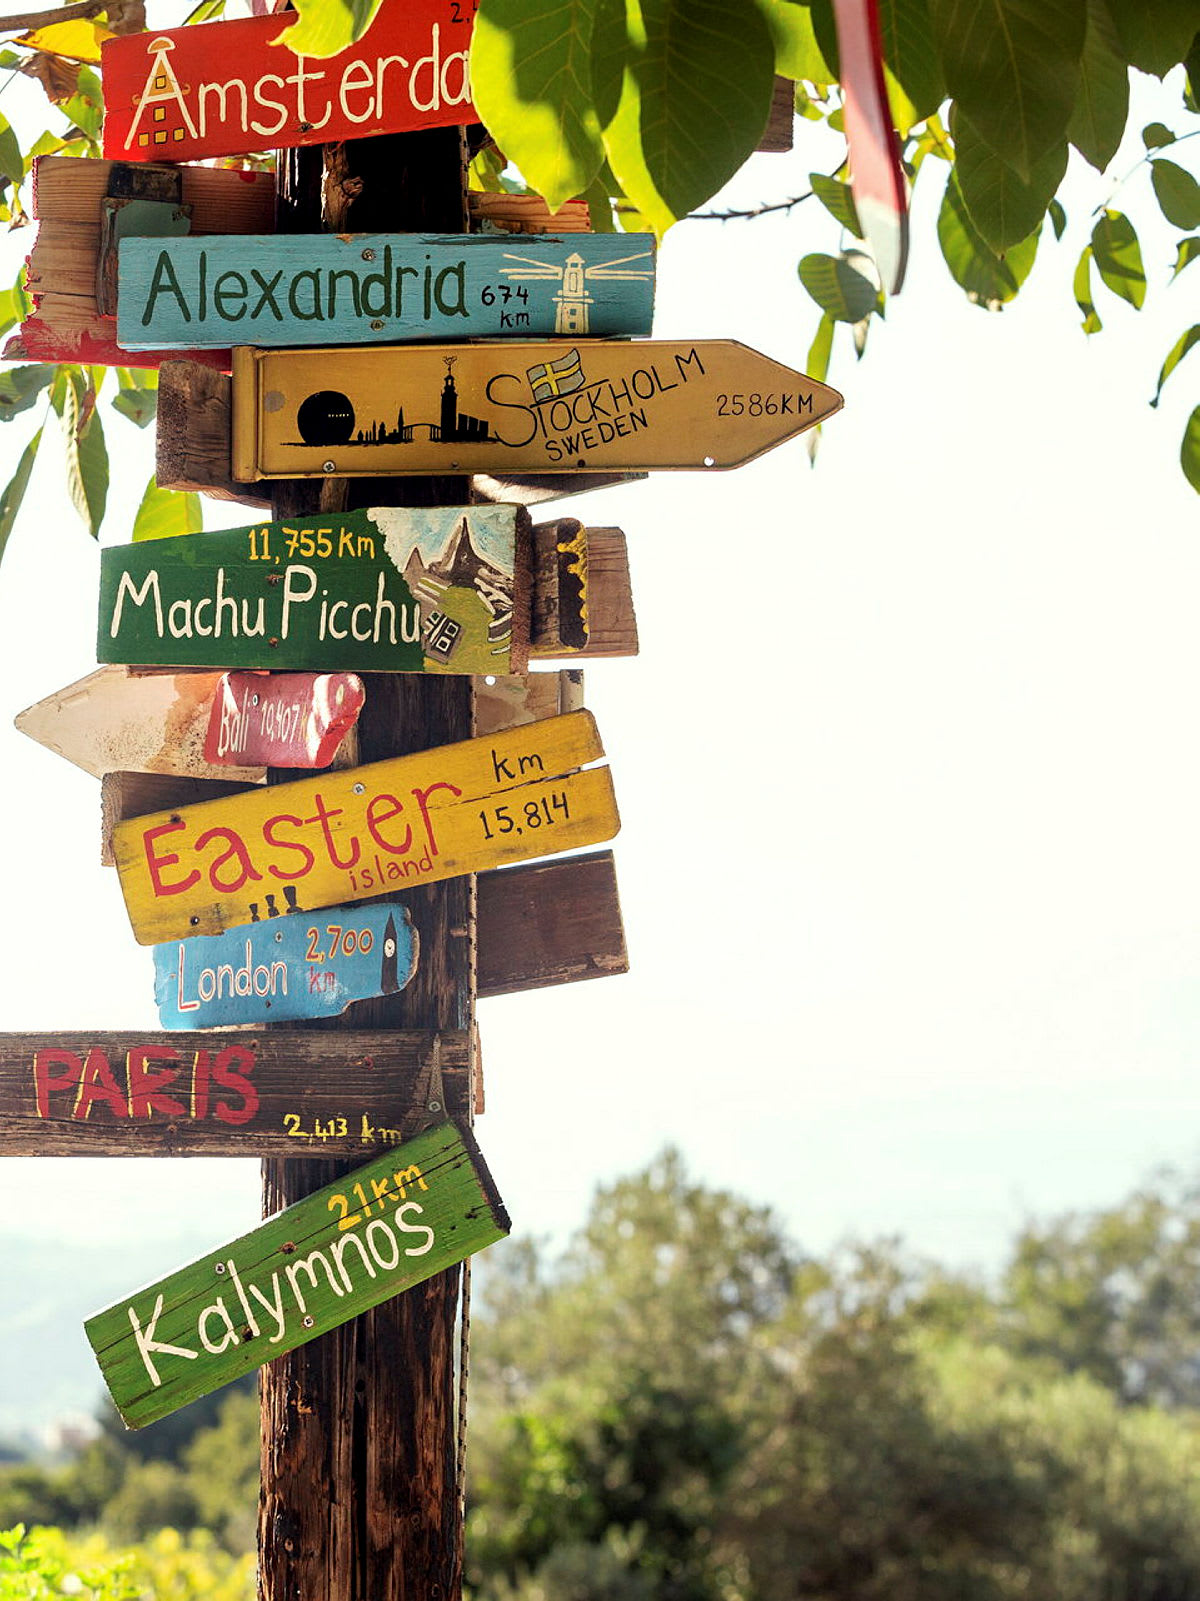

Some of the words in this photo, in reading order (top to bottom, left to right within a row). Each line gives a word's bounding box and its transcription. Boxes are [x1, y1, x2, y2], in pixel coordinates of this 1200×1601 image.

[125, 23, 471, 150] Amsterda
[142, 245, 470, 326] Alexandria
[481, 285, 529, 306] 674
[486, 348, 705, 447] STOCKHOLM
[545, 408, 649, 461] SWEDEN
[111, 568, 265, 639] Machu
[281, 565, 421, 643] Picchu
[217, 687, 250, 757] Bali
[260, 699, 301, 744] 10,407
[492, 749, 544, 783] km
[143, 782, 463, 897] Easter
[480, 792, 570, 840] 15,814
[350, 846, 434, 892] island
[177, 940, 288, 1013] London
[305, 925, 374, 964] 2,700
[308, 965, 336, 994] km
[33, 1044, 260, 1125] PARIS
[283, 1113, 348, 1143] 2,413
[361, 1113, 401, 1144] km
[128, 1201, 435, 1386] Kalymnos
